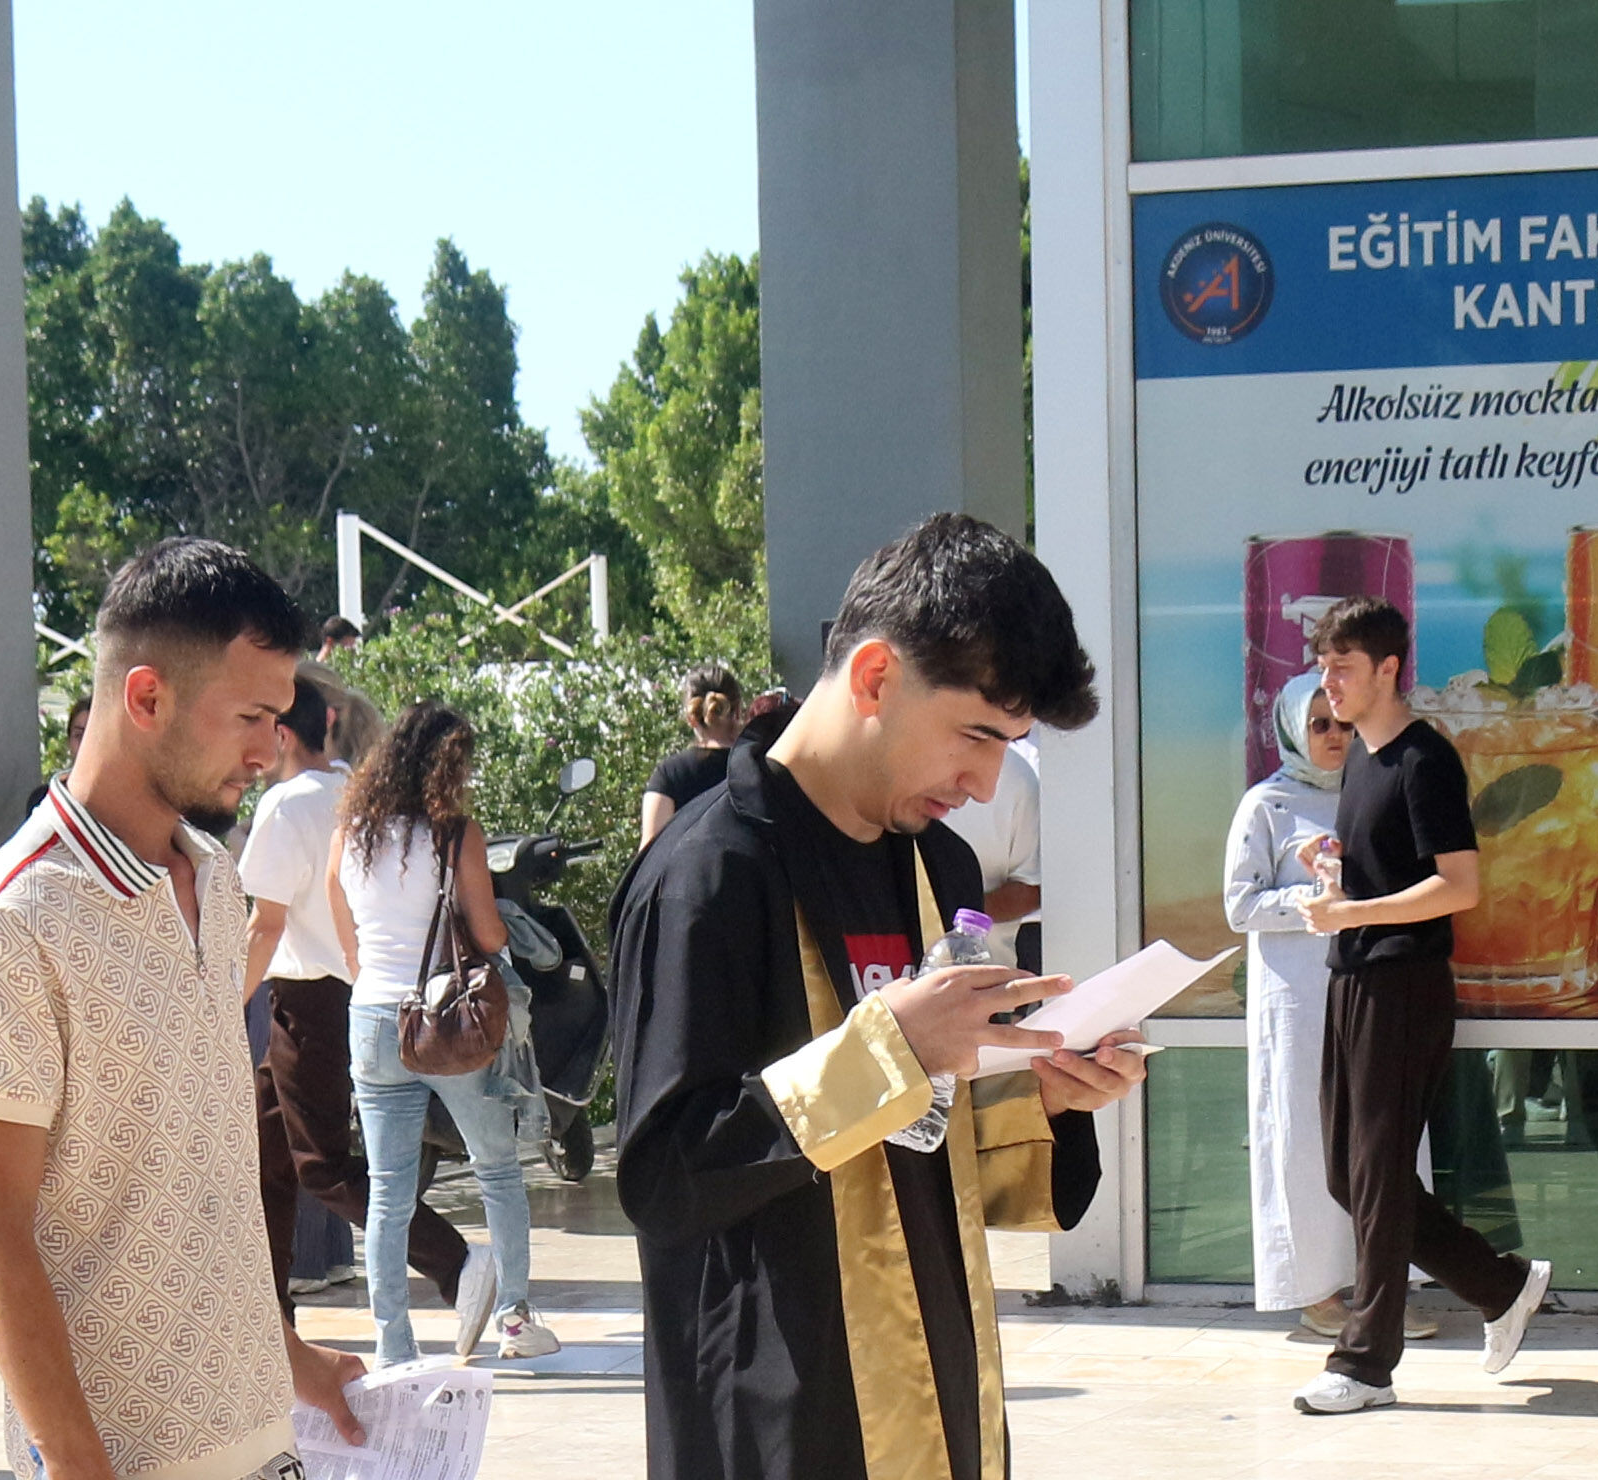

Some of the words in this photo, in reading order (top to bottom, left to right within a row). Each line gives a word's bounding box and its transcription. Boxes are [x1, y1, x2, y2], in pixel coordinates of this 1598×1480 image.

[1328, 210, 1502, 271] EĞİTİM
[1316, 383, 1464, 423] Alkolsüz
[1304, 445, 1433, 495] enerjiyi
[1438, 443, 1509, 481] tatlı
